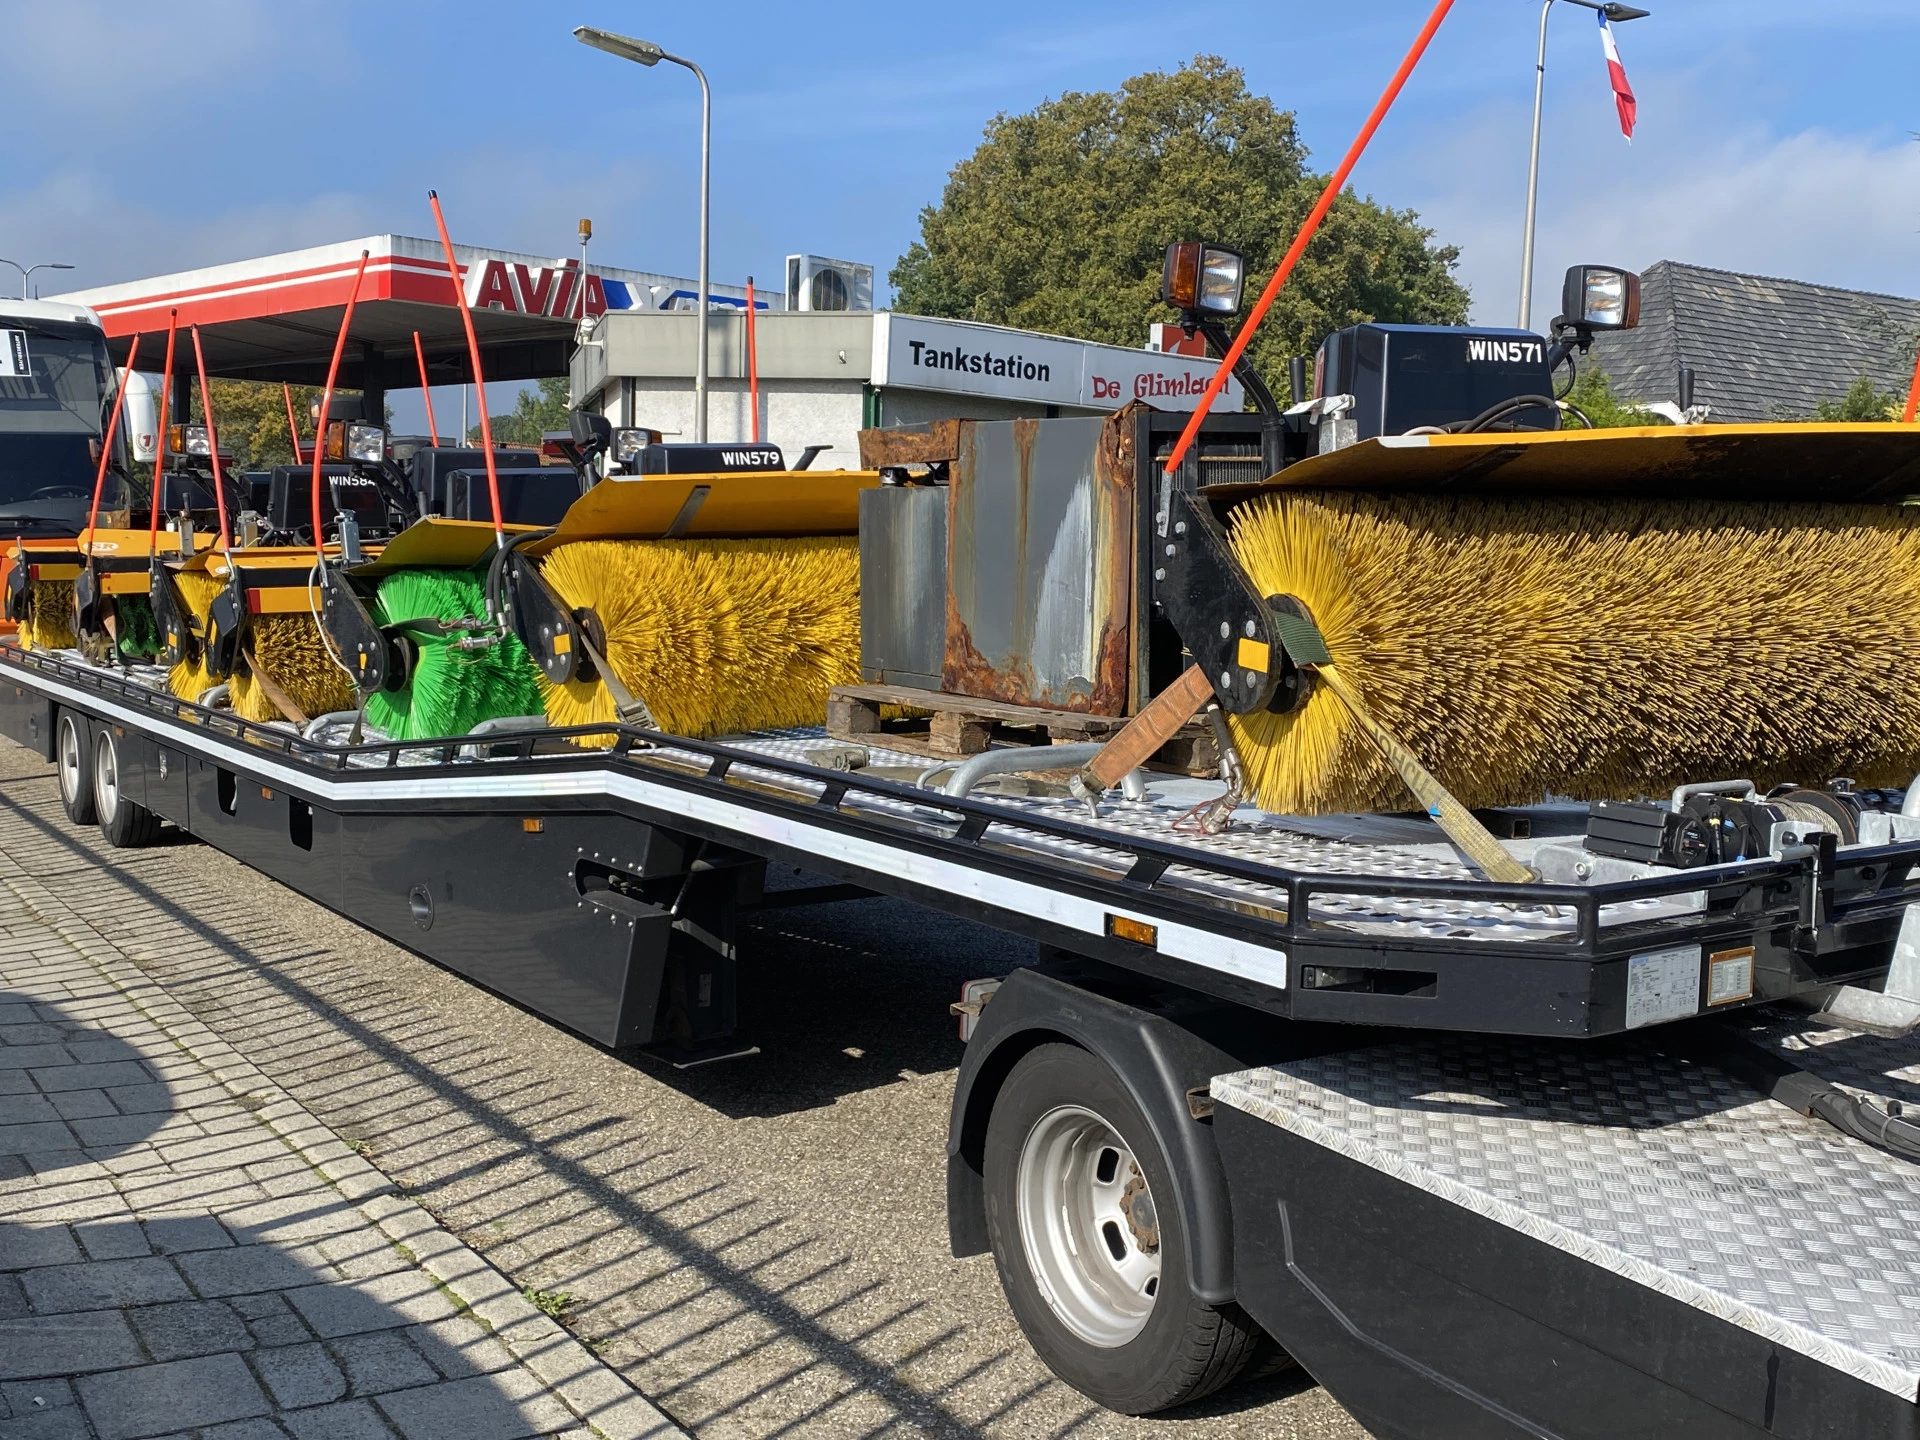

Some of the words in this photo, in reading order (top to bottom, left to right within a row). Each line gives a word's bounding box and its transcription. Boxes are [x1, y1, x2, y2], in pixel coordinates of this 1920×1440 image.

[909, 340, 1050, 382] Tankstation
[1469, 340, 1542, 363] WIN571
[1092, 376, 1121, 399] De
[721, 451, 779, 466] WIN579
